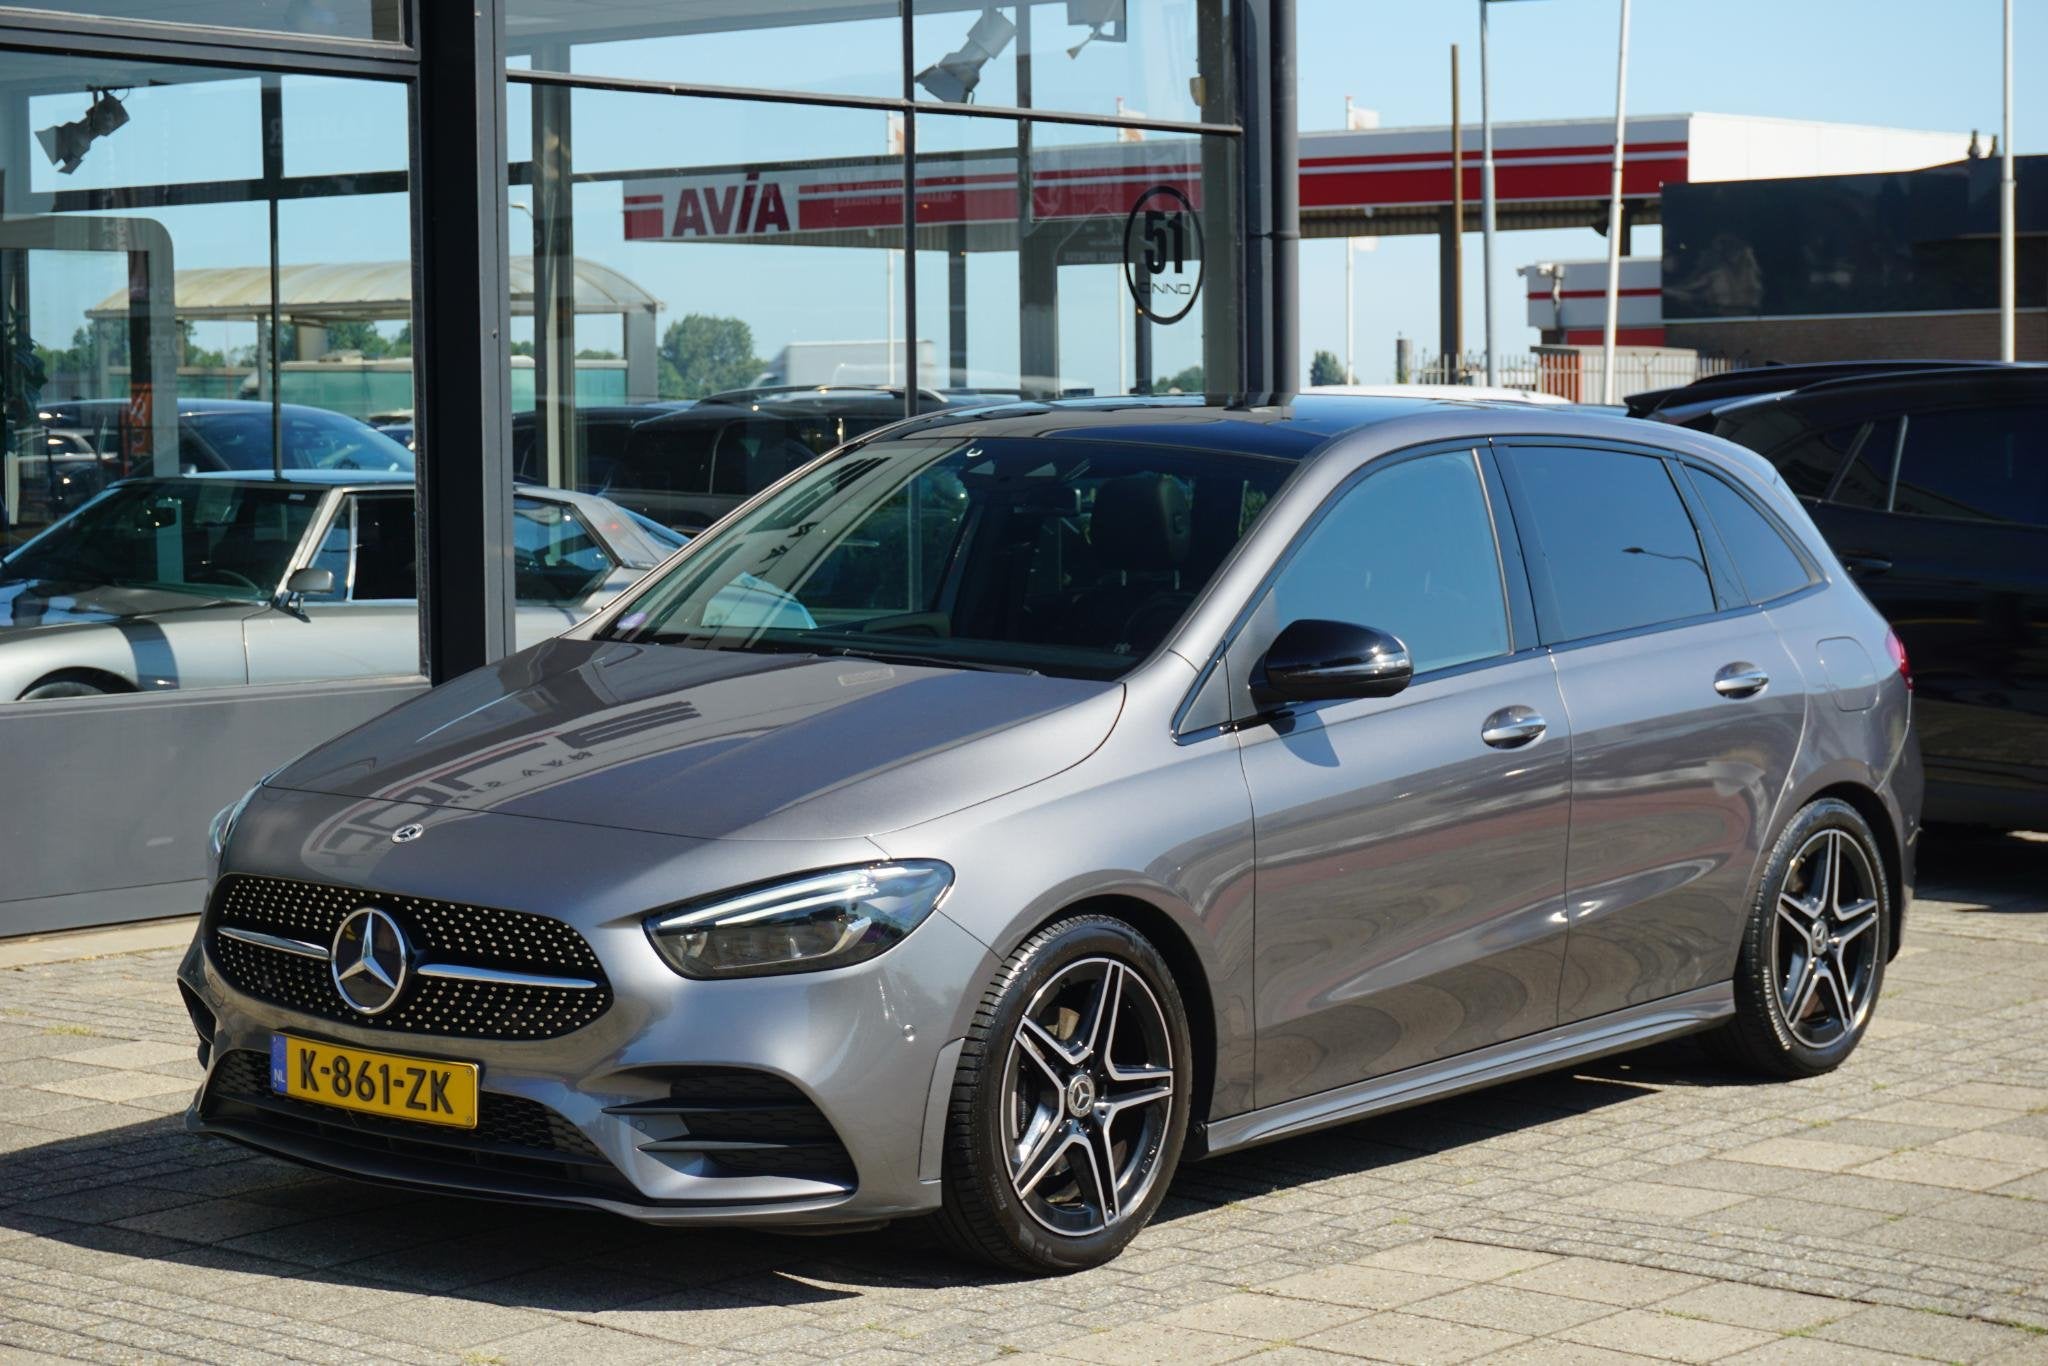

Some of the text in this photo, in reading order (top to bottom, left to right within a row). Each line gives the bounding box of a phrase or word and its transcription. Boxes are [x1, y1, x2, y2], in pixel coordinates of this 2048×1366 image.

[672, 171, 790, 237] AVIA
[1145, 210, 1183, 274] 51
[274, 1069, 286, 1083] NL
[299, 1048, 453, 1114] K-861-ZK
